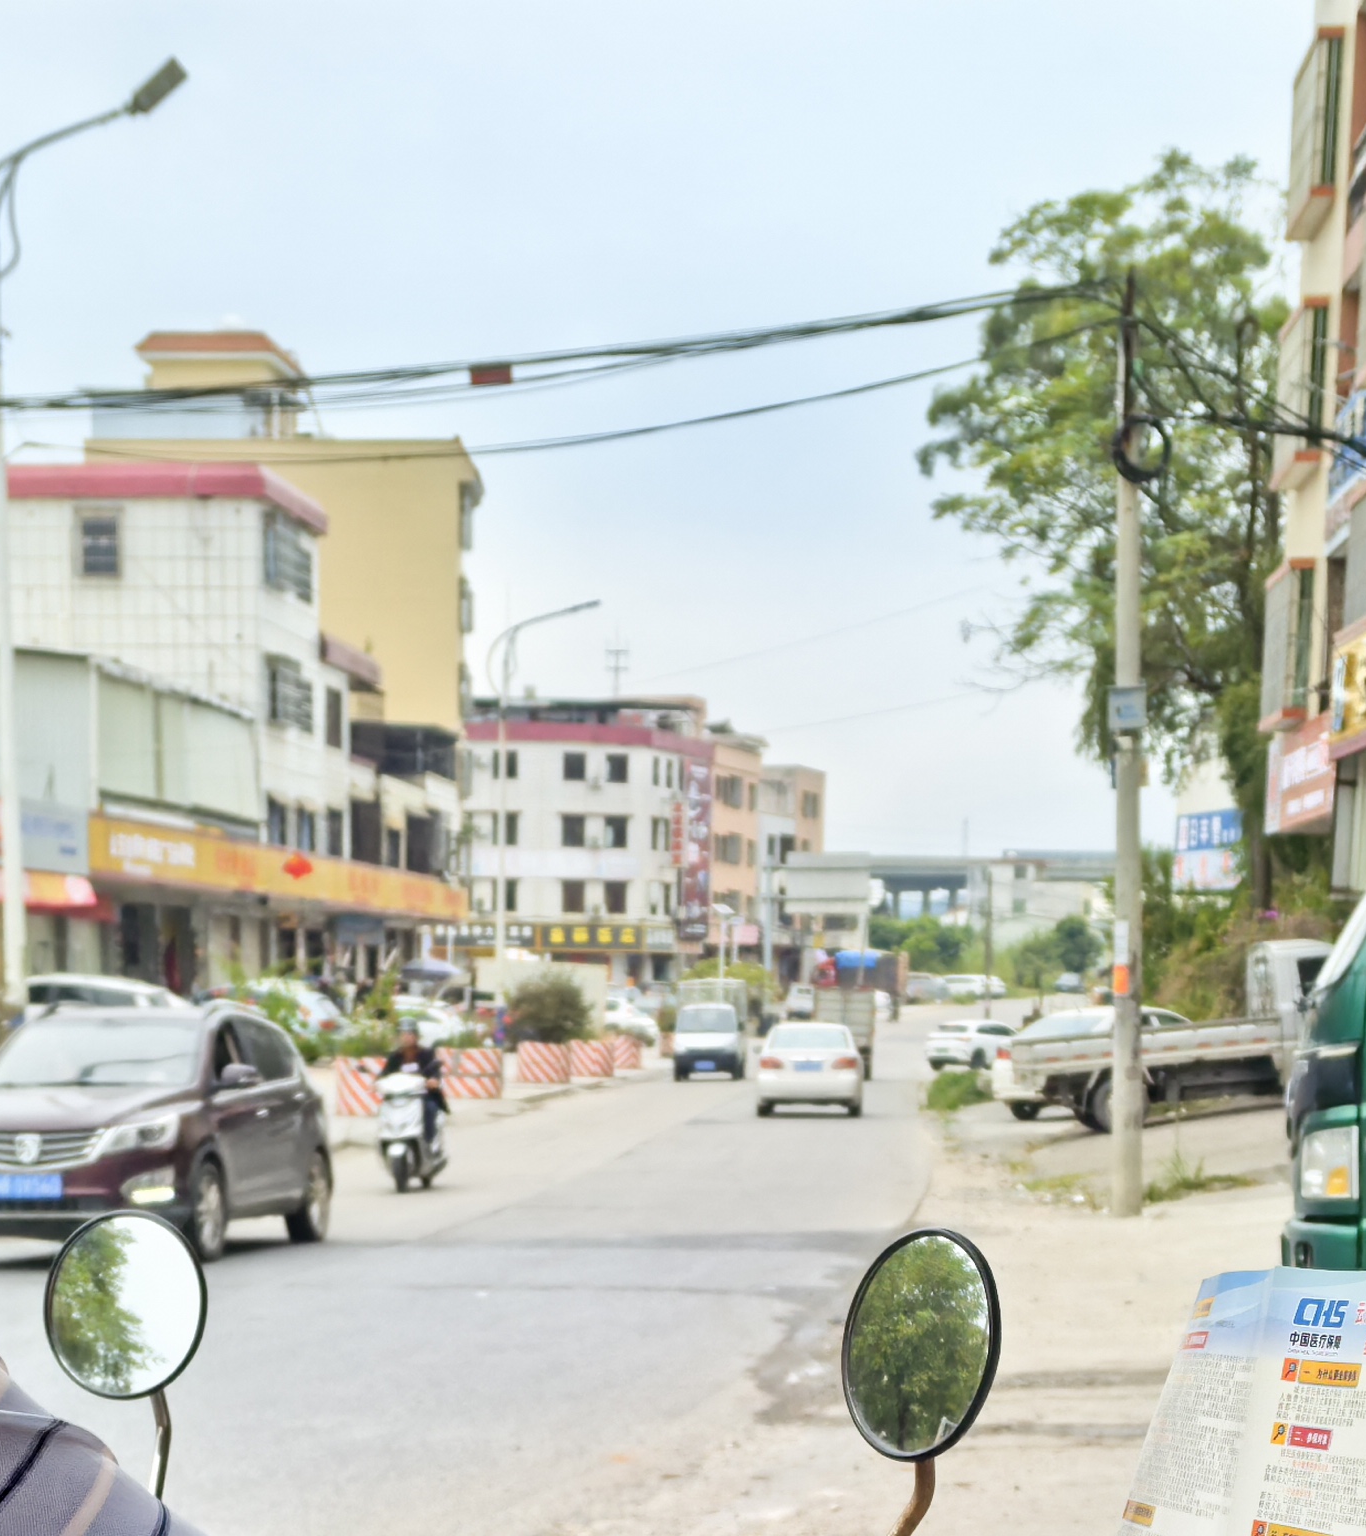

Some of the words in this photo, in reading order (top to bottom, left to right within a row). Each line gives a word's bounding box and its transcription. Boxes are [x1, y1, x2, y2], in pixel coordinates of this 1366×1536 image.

[1292, 1297, 1350, 1328] CHS
[1288, 1331, 1343, 1351] 中国医疗保障
